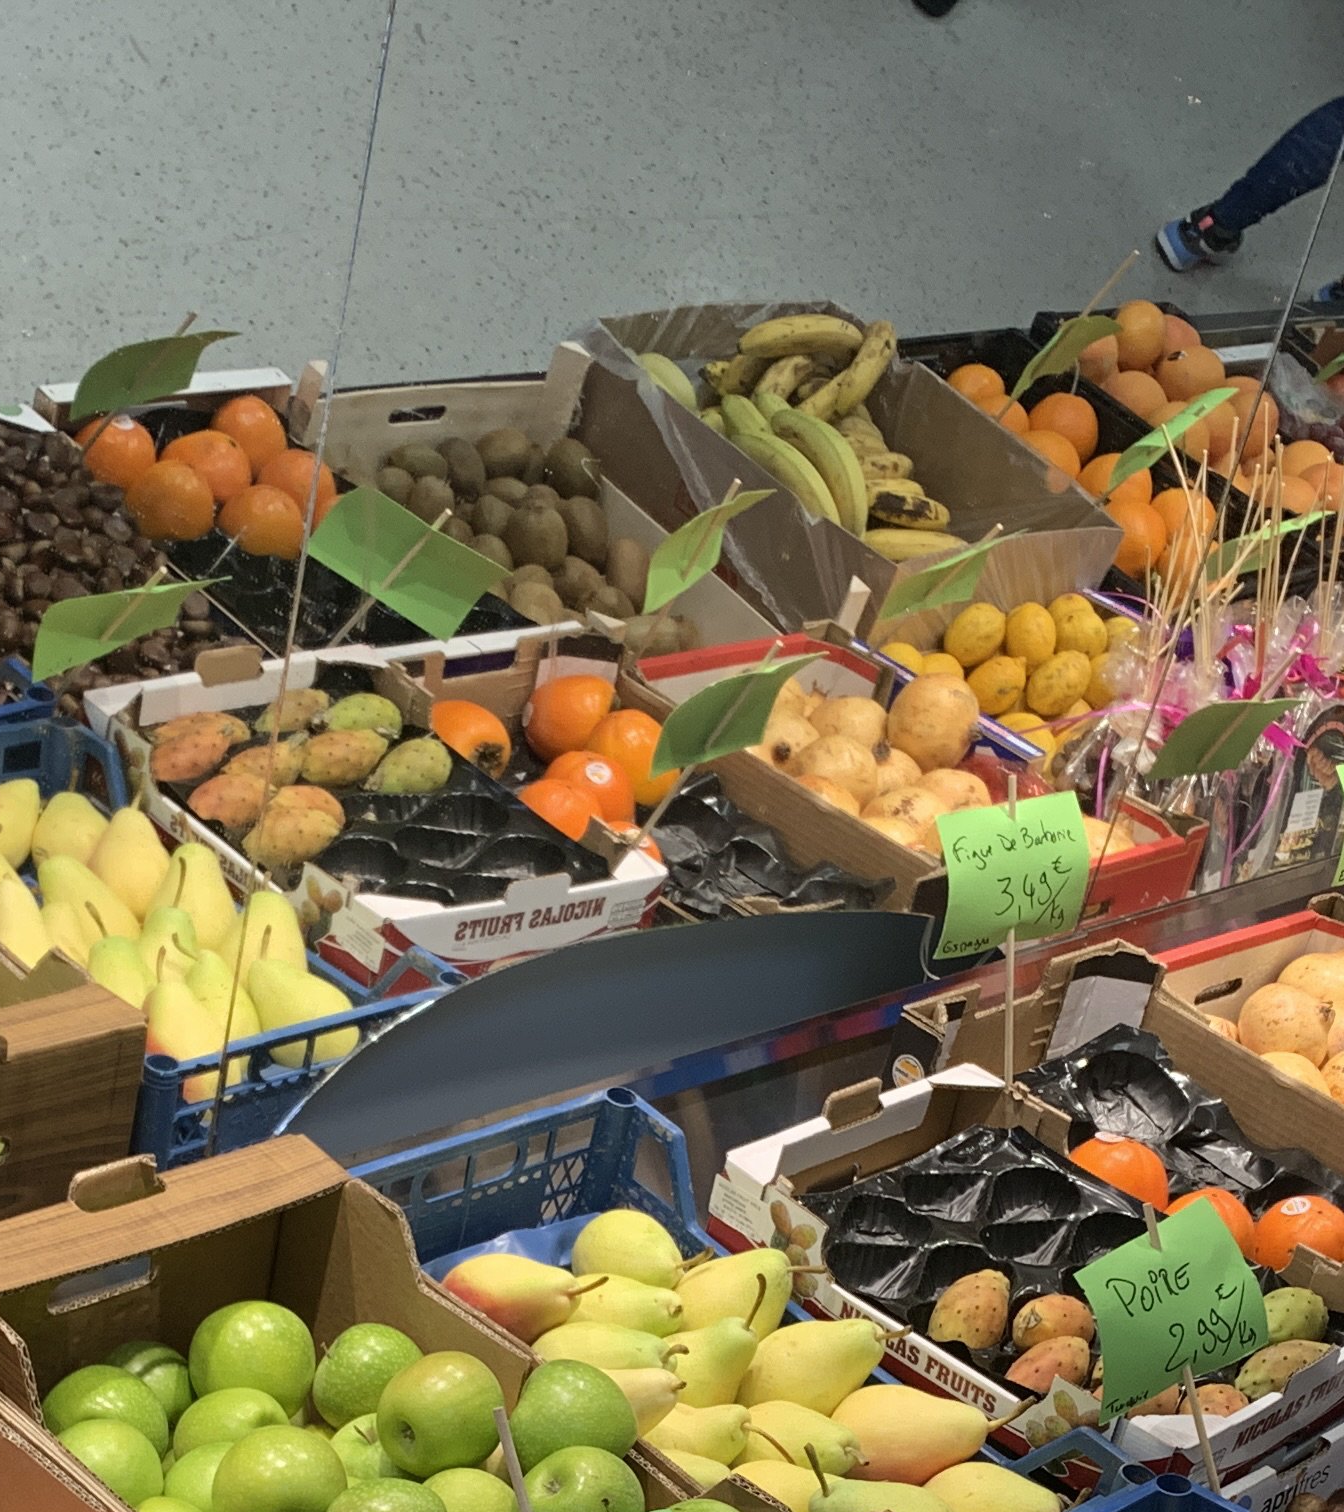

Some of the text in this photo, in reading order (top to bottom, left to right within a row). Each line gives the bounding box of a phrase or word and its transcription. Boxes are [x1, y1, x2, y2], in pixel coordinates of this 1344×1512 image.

[953, 836, 992, 870] Figue
[997, 834, 1016, 851] De
[924, 1355, 997, 1414] FRUITS
[1231, 1395, 1306, 1452] NICOLAS
